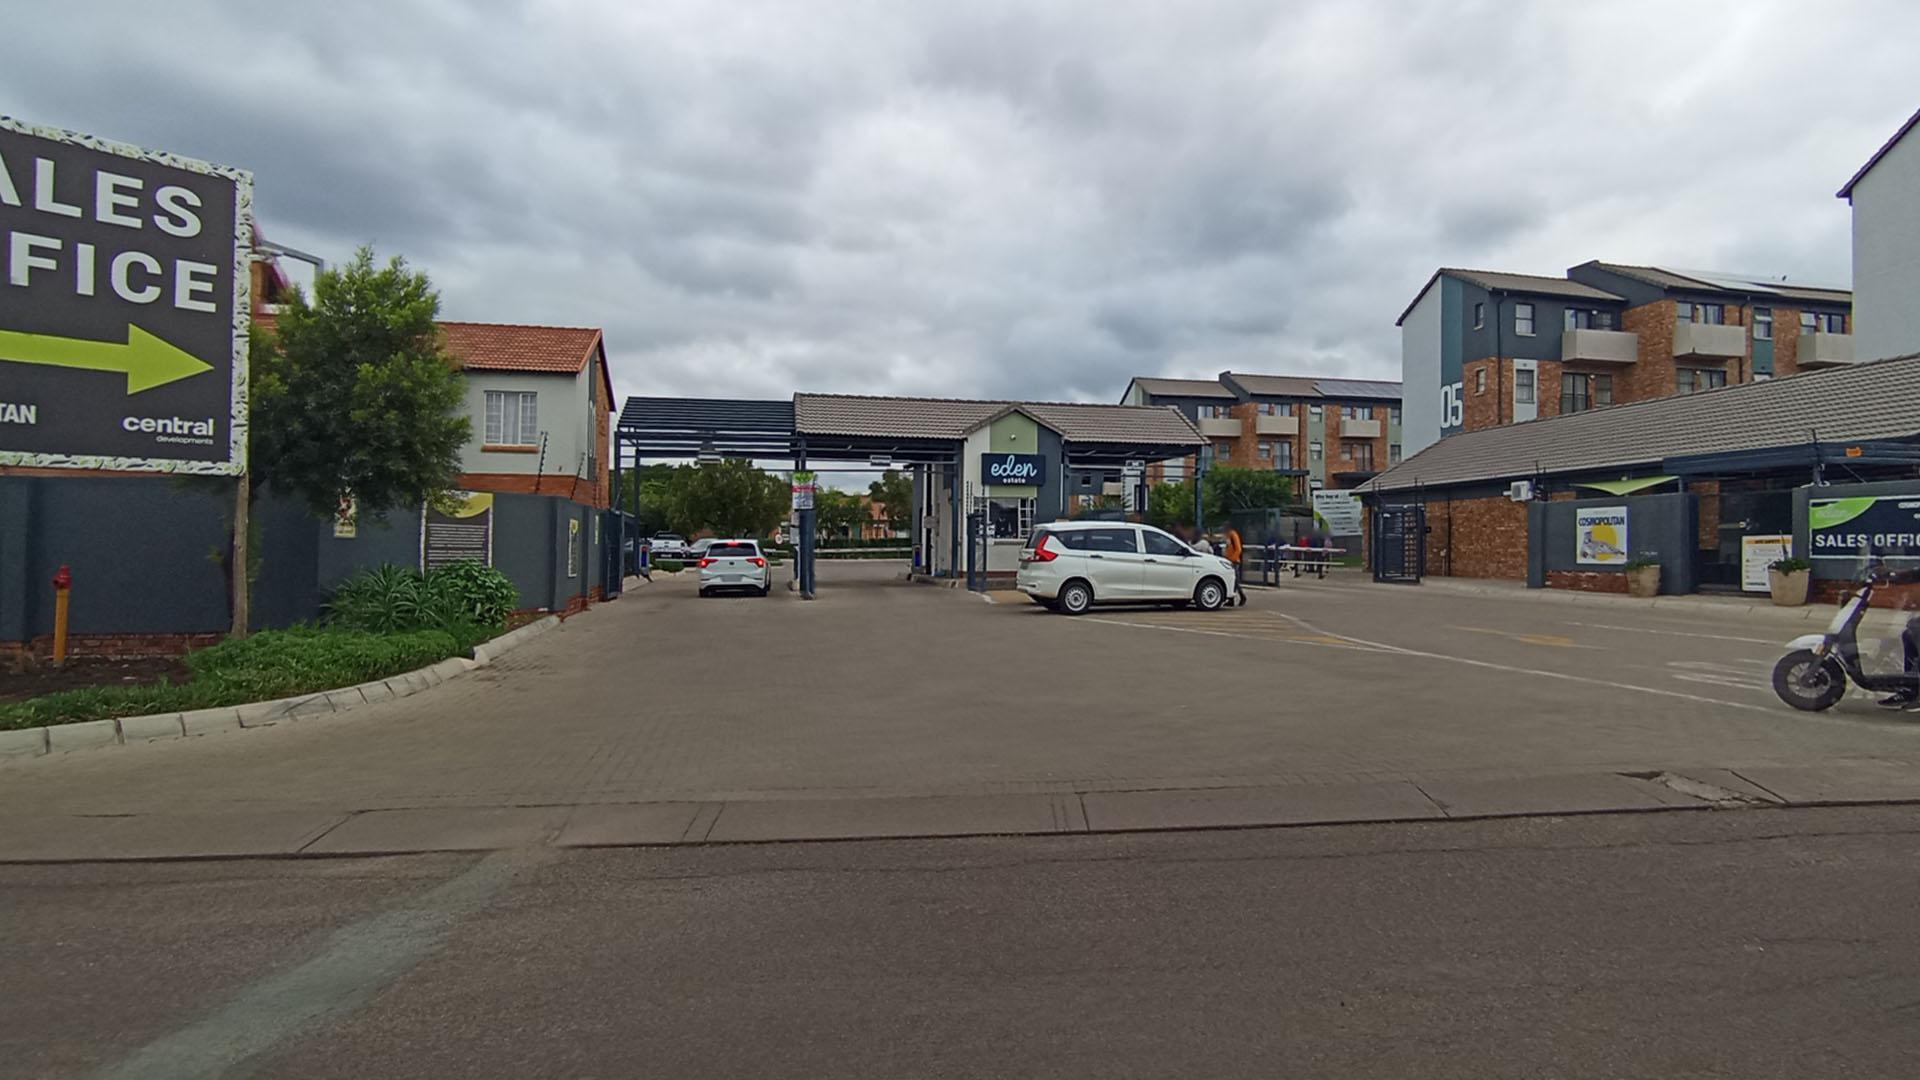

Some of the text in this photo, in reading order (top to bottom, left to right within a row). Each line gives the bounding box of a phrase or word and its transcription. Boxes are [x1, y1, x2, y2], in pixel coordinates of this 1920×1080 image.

[10, 231, 218, 313] FICE
[1440, 381, 1463, 429] 05
[122, 416, 214, 436] central
[156, 435, 214, 445] developments
[991, 455, 1037, 477] eden
[1578, 516, 1625, 526] COSMOPOLITAN
[1815, 533, 1868, 547] SALES
